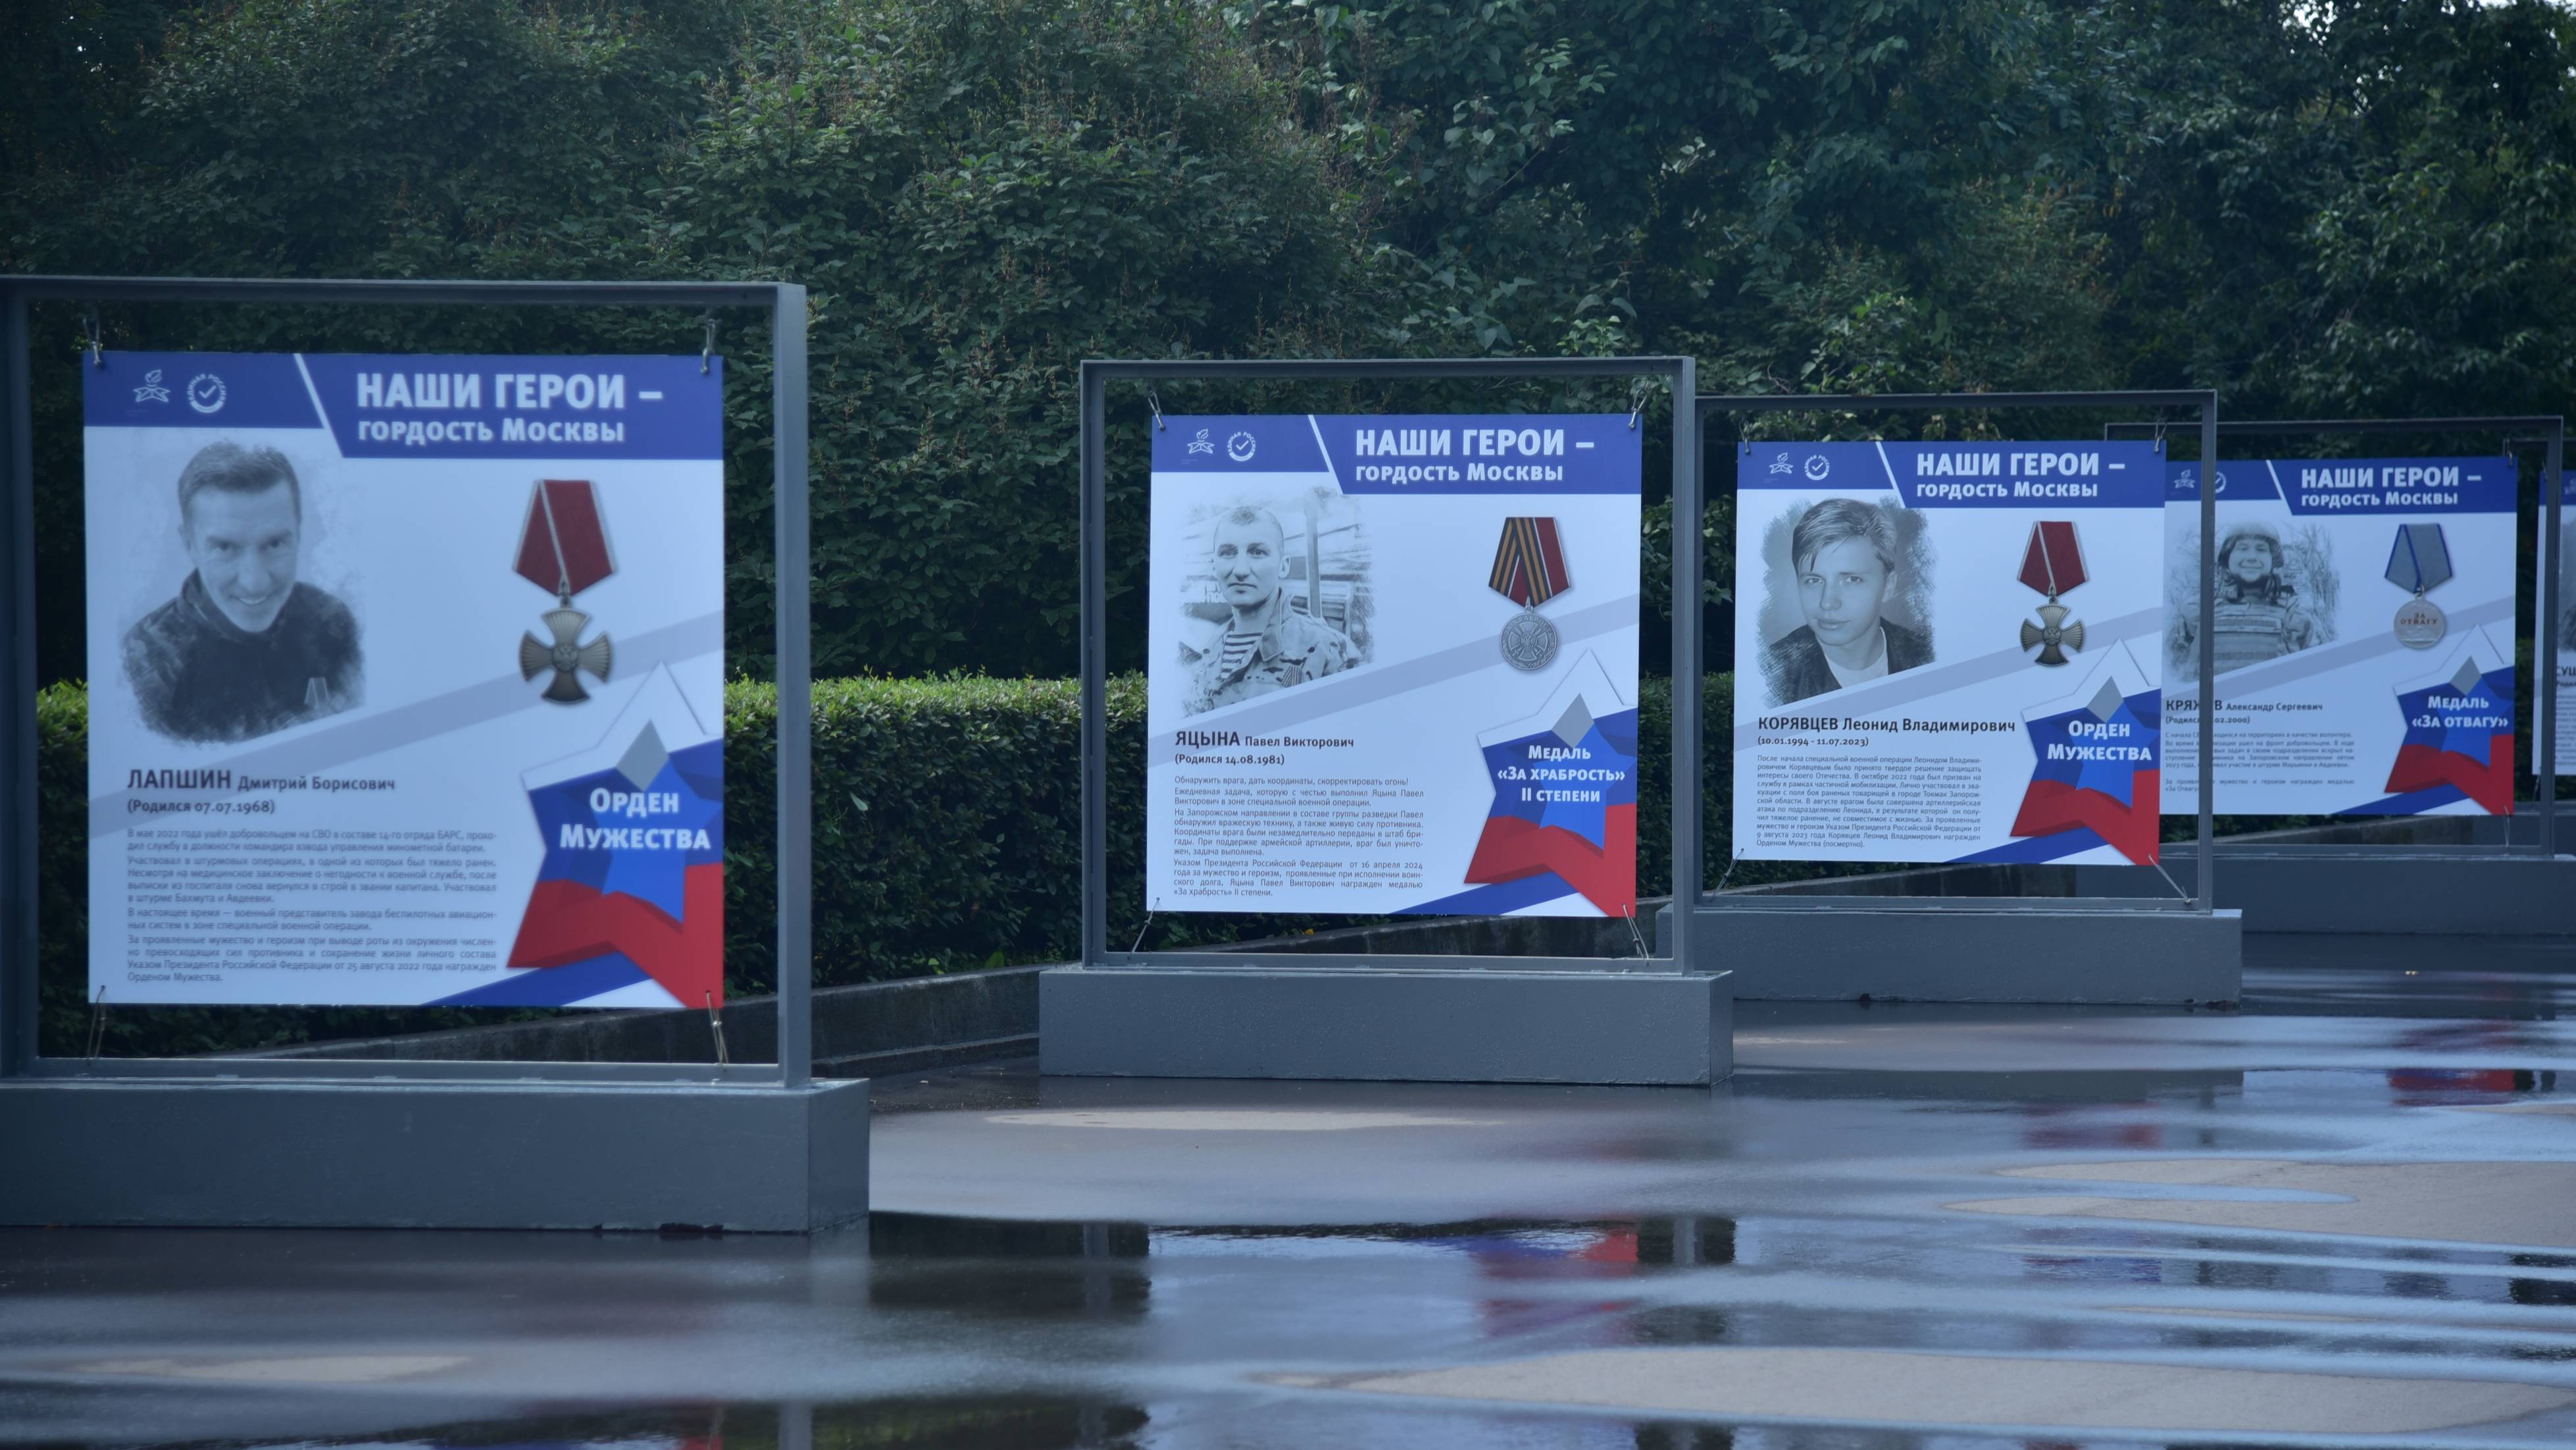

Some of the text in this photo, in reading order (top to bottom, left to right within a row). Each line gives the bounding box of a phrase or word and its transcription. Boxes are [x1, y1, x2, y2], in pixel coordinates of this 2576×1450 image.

[357, 373, 480, 407] НАШИ
[495, 374, 624, 409] ГЕРОИ
[1356, 430, 1451, 455] НАШИ
[1463, 429, 1564, 455] ГЕРОИ
[1917, 453, 2000, 475] НАШИ
[2010, 453, 2099, 475] ГЕРОИ
[2302, 468, 2374, 488] НАШИ
[2382, 467, 2459, 487] ГЕРОИ
[2225, 703, 2274, 712] Александр
[2275, 703, 2323, 712] Сергеевич
[1758, 717, 2015, 735] КОРЯВЦЕВ Леонид Владимирович
[1175, 731, 1354, 749] ЯЦЫНА Павел Викторович
[1174, 754, 1285, 765] (Родился 14.08.1981)
[127, 769, 395, 792] ЛАПШИН Дмитрий Борисович
[1371, 789, 1397, 798] Яцына
[1400, 789, 1424, 798] Павел
[127, 799, 276, 815] (Родился 07.07.1968)
[1298, 798, 1330, 806] военной
[1332, 800, 1372, 809] операции.
